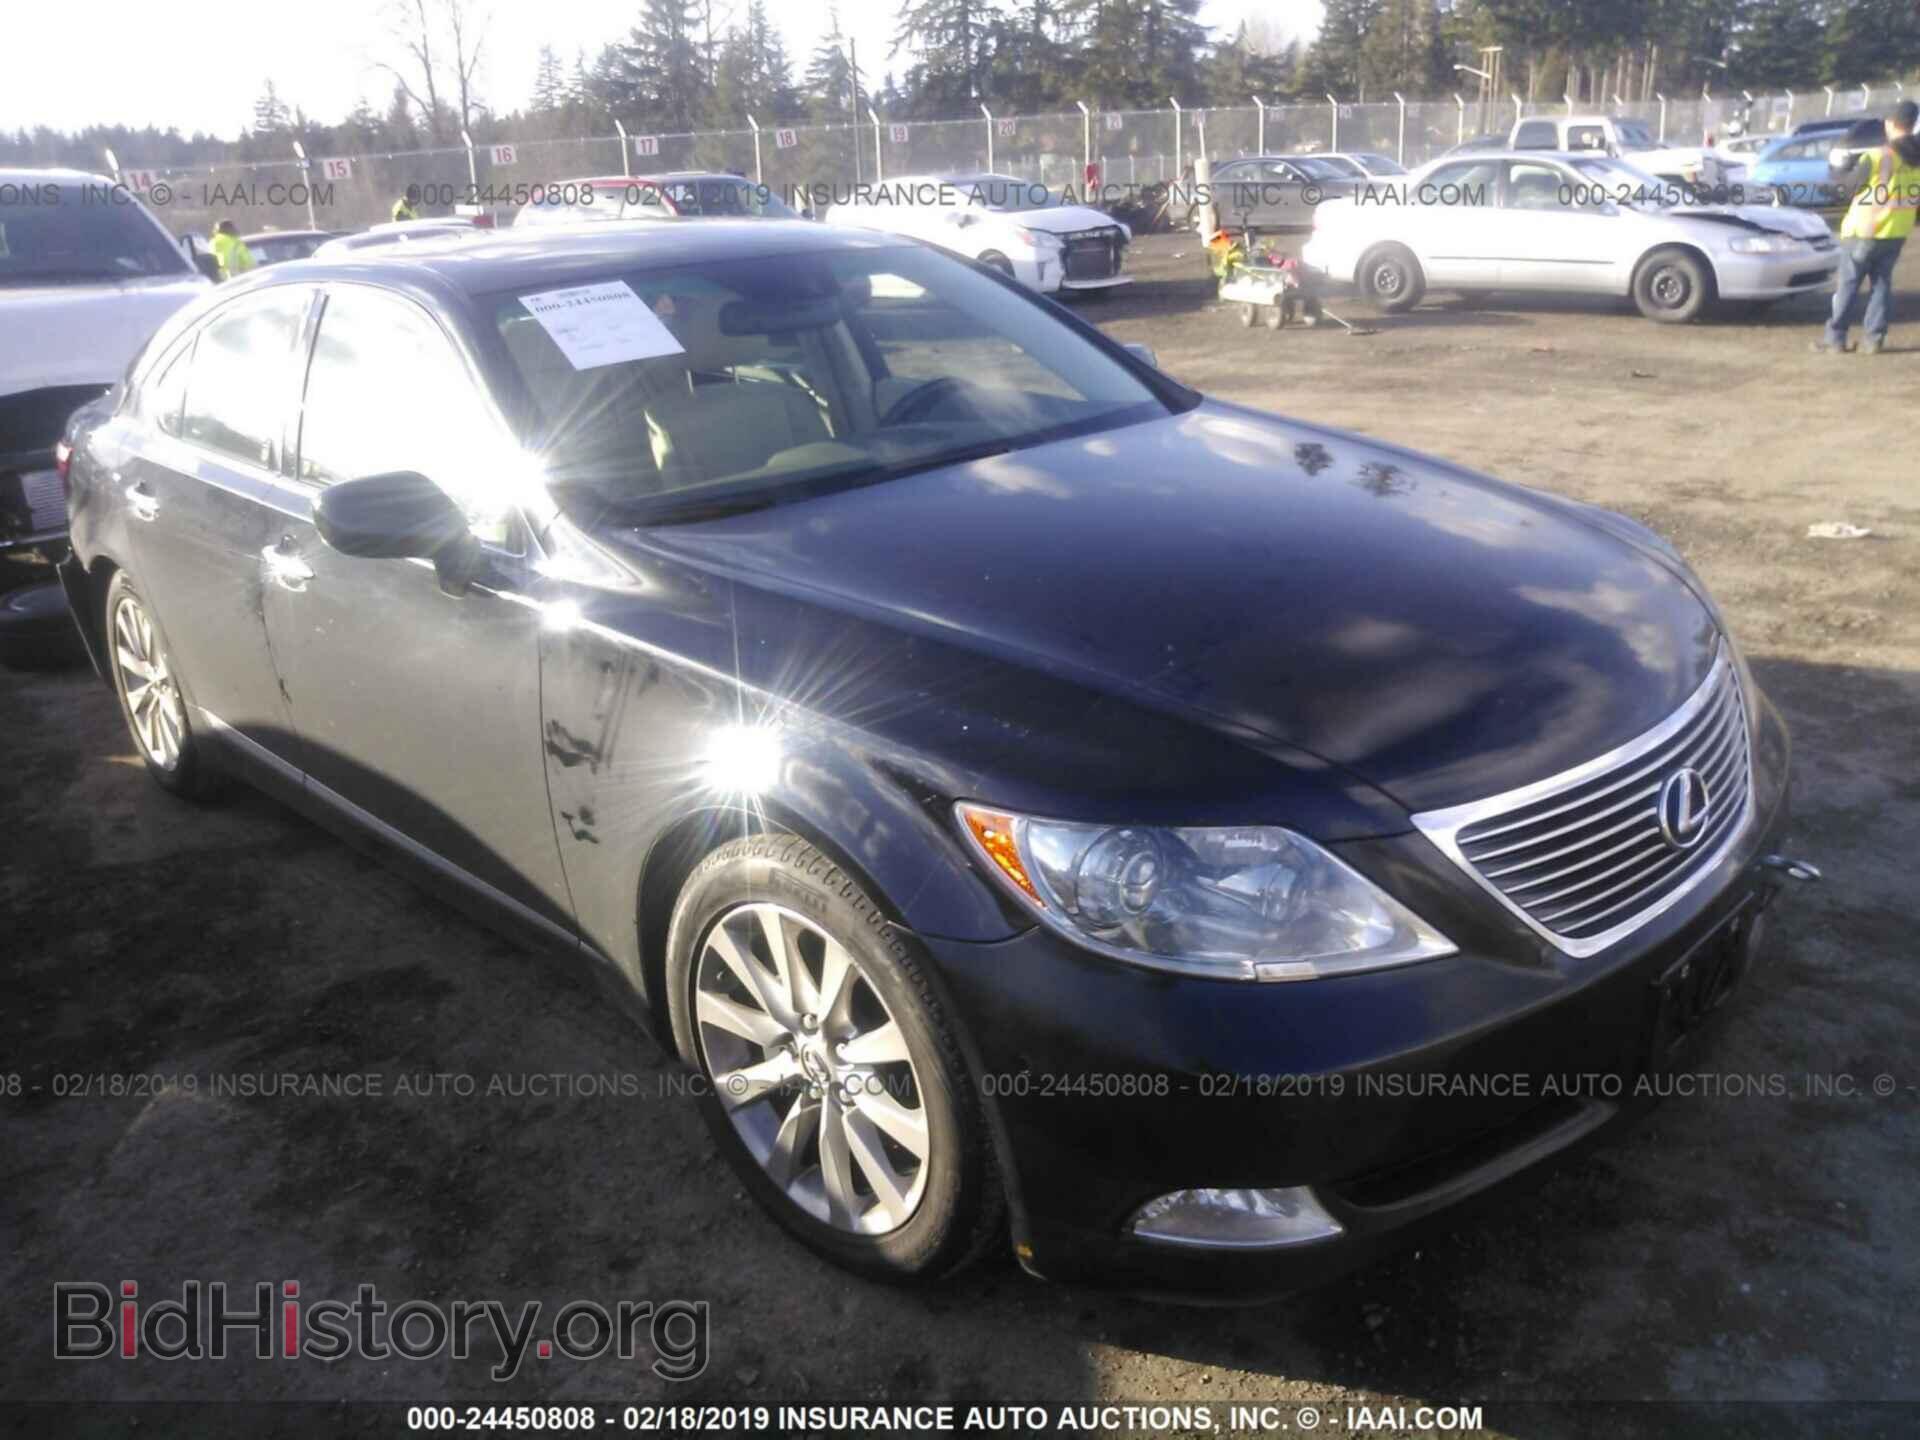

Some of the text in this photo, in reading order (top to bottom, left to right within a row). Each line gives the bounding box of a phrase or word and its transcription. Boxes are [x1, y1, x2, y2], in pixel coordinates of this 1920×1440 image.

[640, 138, 653, 153] 17
[779, 131, 794, 146] 18
[495, 147, 512, 163] 16
[328, 161, 347, 177] 15
[131, 172, 152, 191] 14
